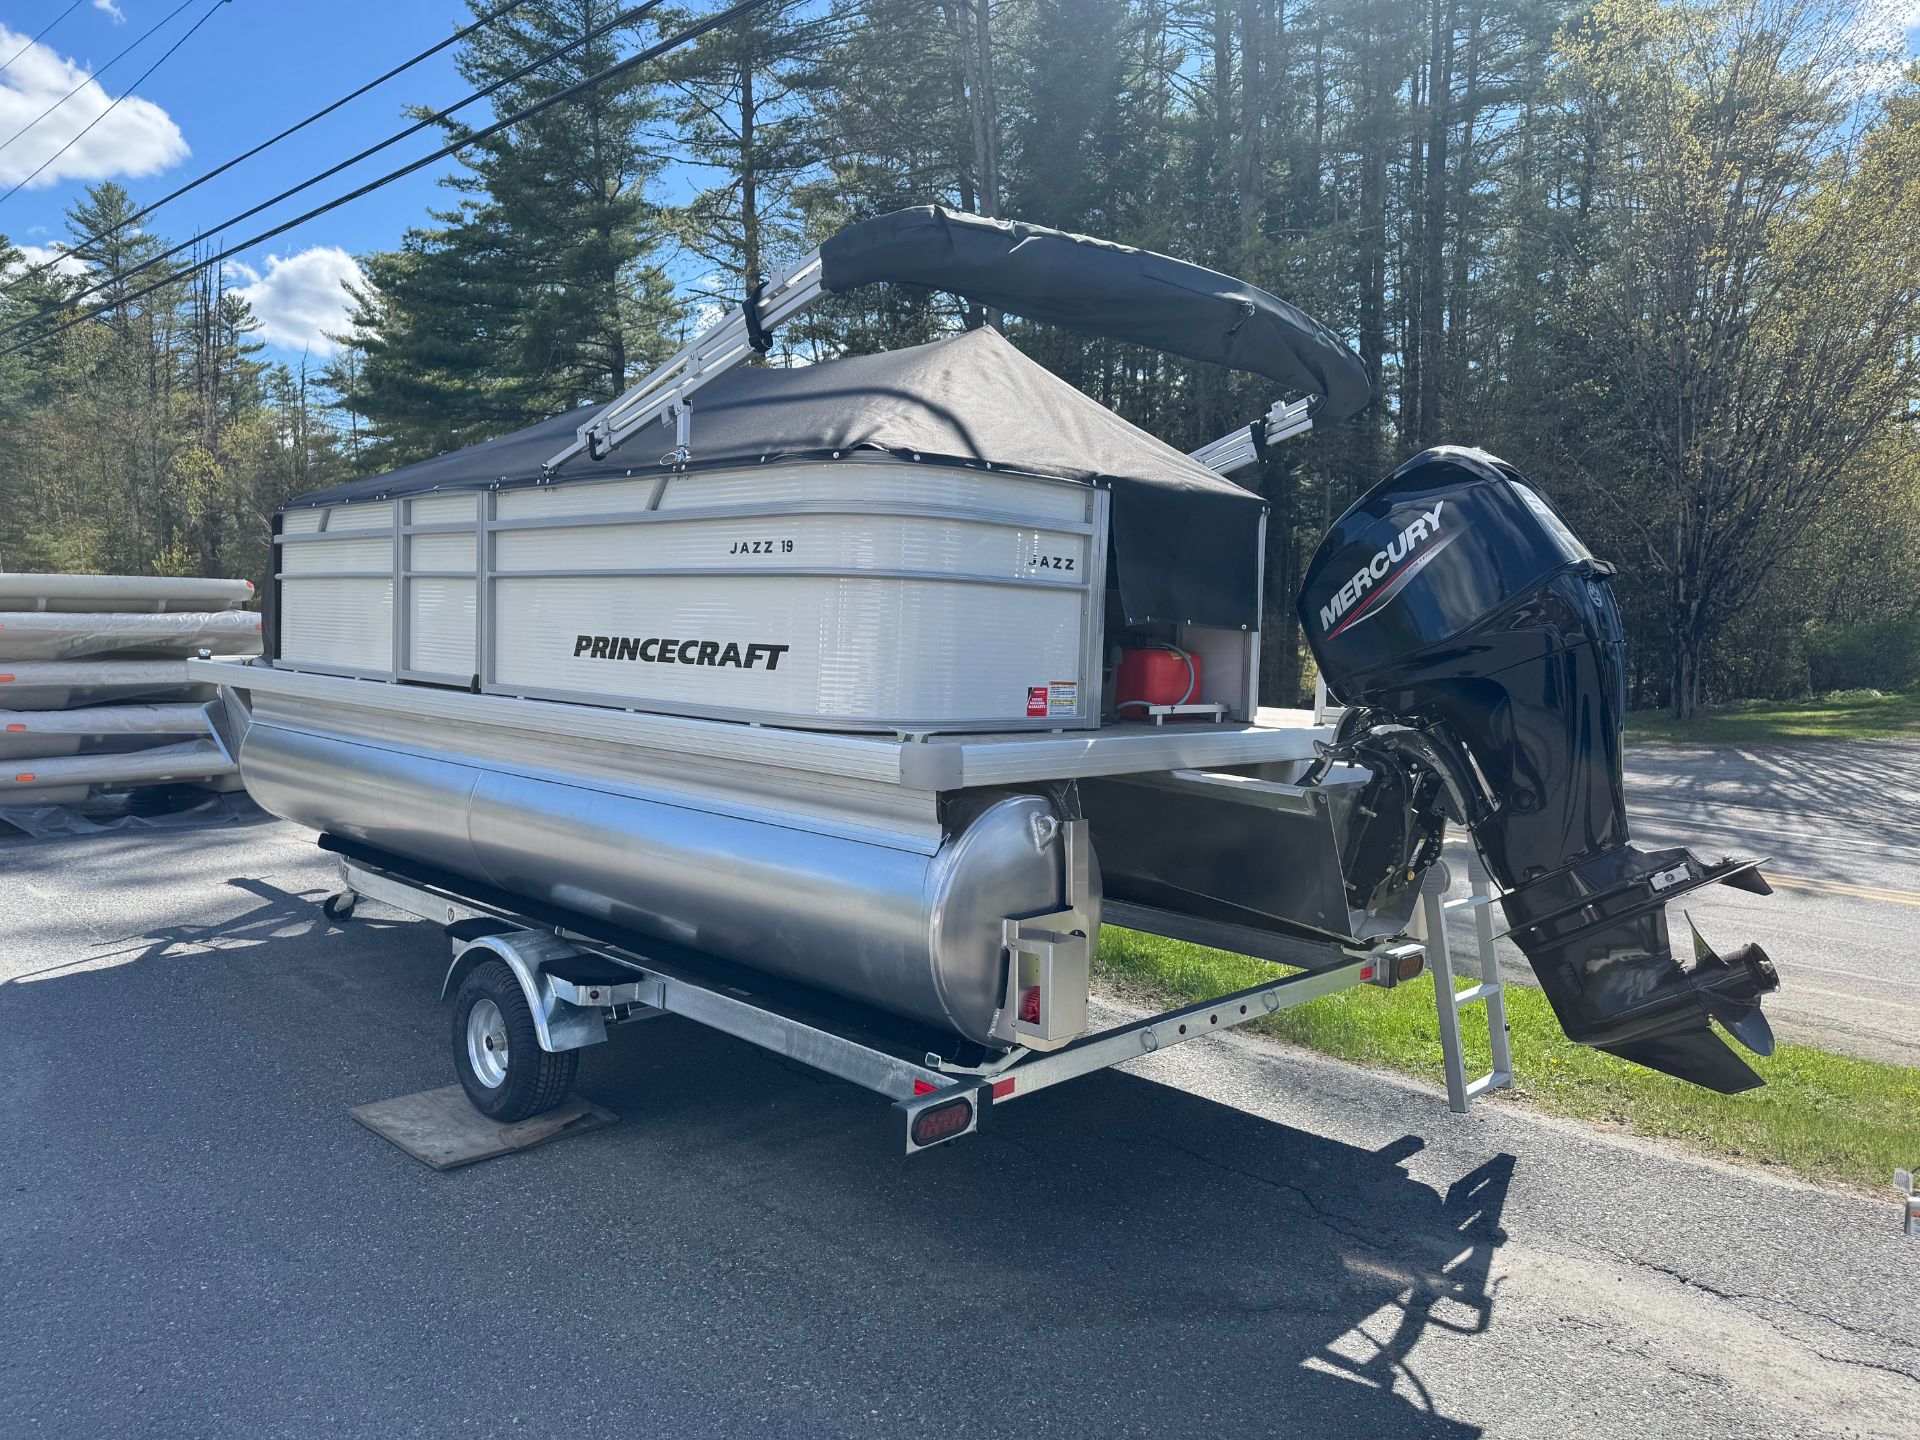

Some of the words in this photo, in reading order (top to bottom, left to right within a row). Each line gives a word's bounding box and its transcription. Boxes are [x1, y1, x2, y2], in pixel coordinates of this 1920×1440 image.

[730, 541, 773, 554] JAZZ
[781, 539, 793, 553] 19
[1029, 555, 1074, 570] JAZZ
[1319, 500, 1444, 632] MERCURY
[573, 635, 790, 670] PRINCECRAFT
